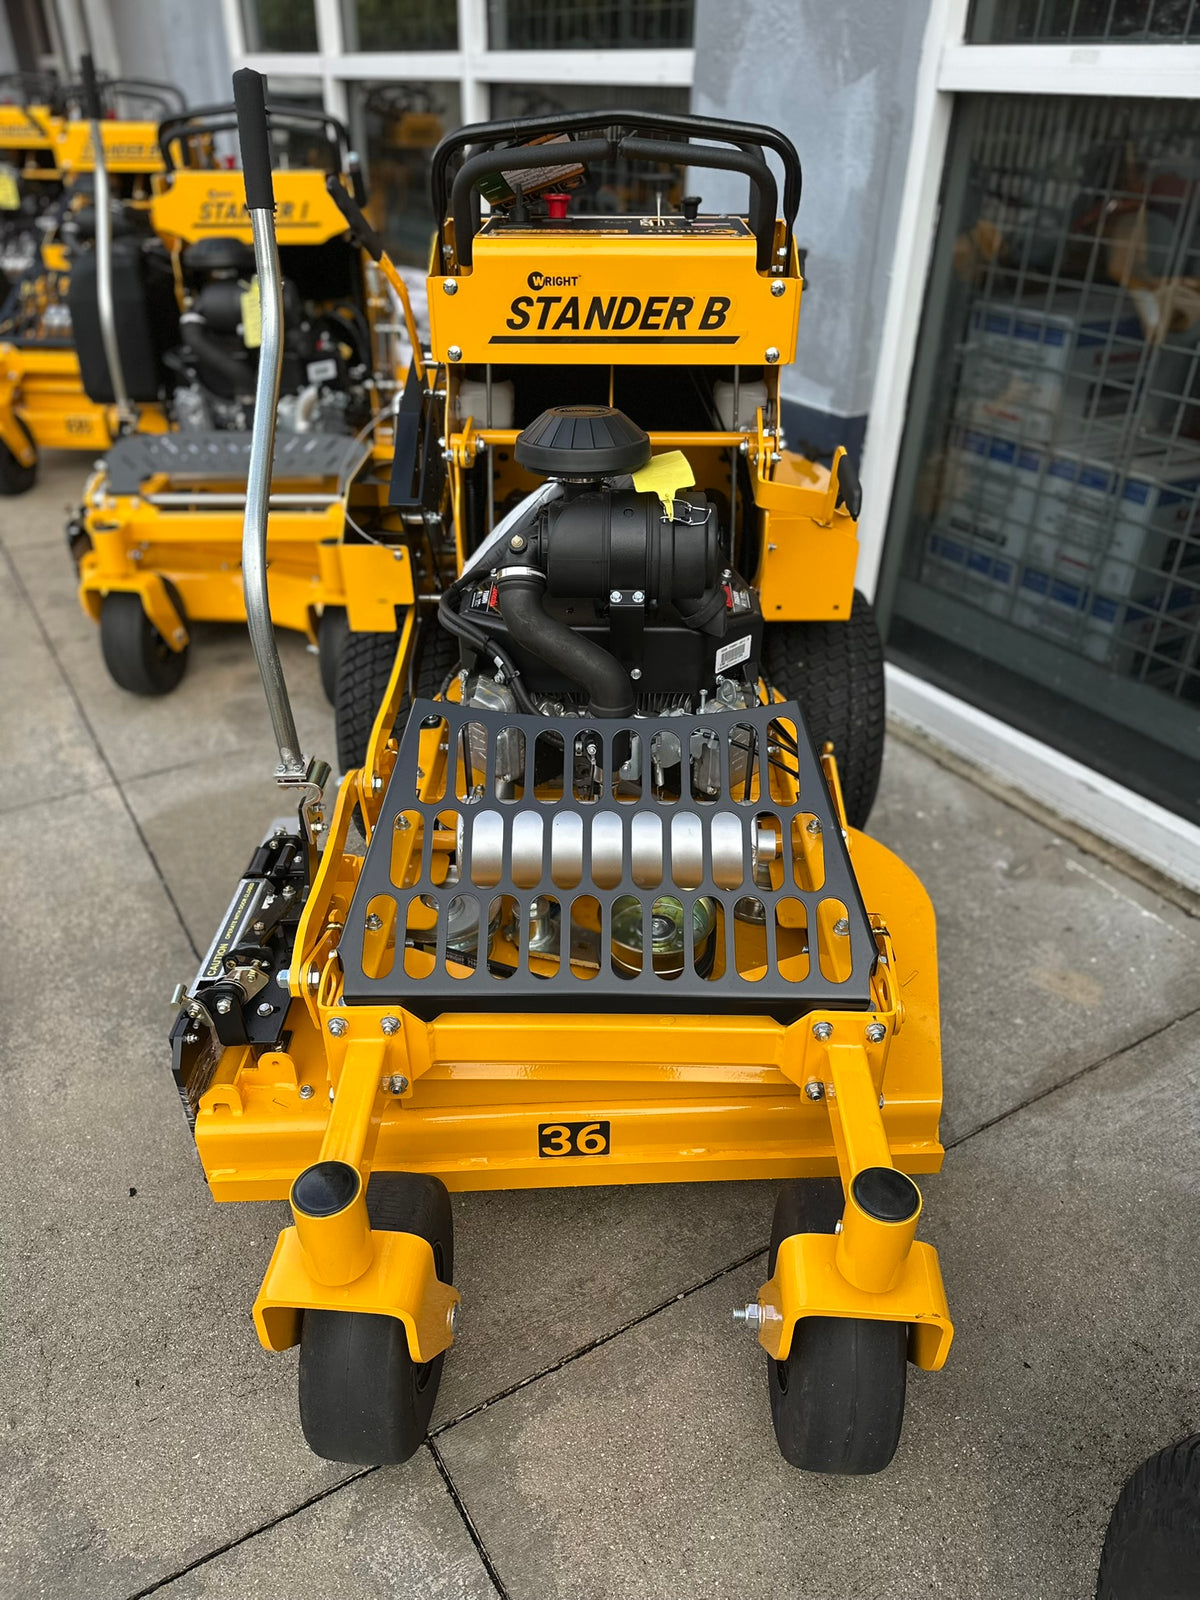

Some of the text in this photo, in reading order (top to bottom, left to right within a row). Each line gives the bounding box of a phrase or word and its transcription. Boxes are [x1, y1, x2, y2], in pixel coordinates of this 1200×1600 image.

[527, 271, 578, 291] WRIGHT
[506, 296, 731, 330] STANDER B
[207, 883, 254, 976] CAUTION OPERATE WITH DOOR CLOSED
[541, 1123, 607, 1156] 36
